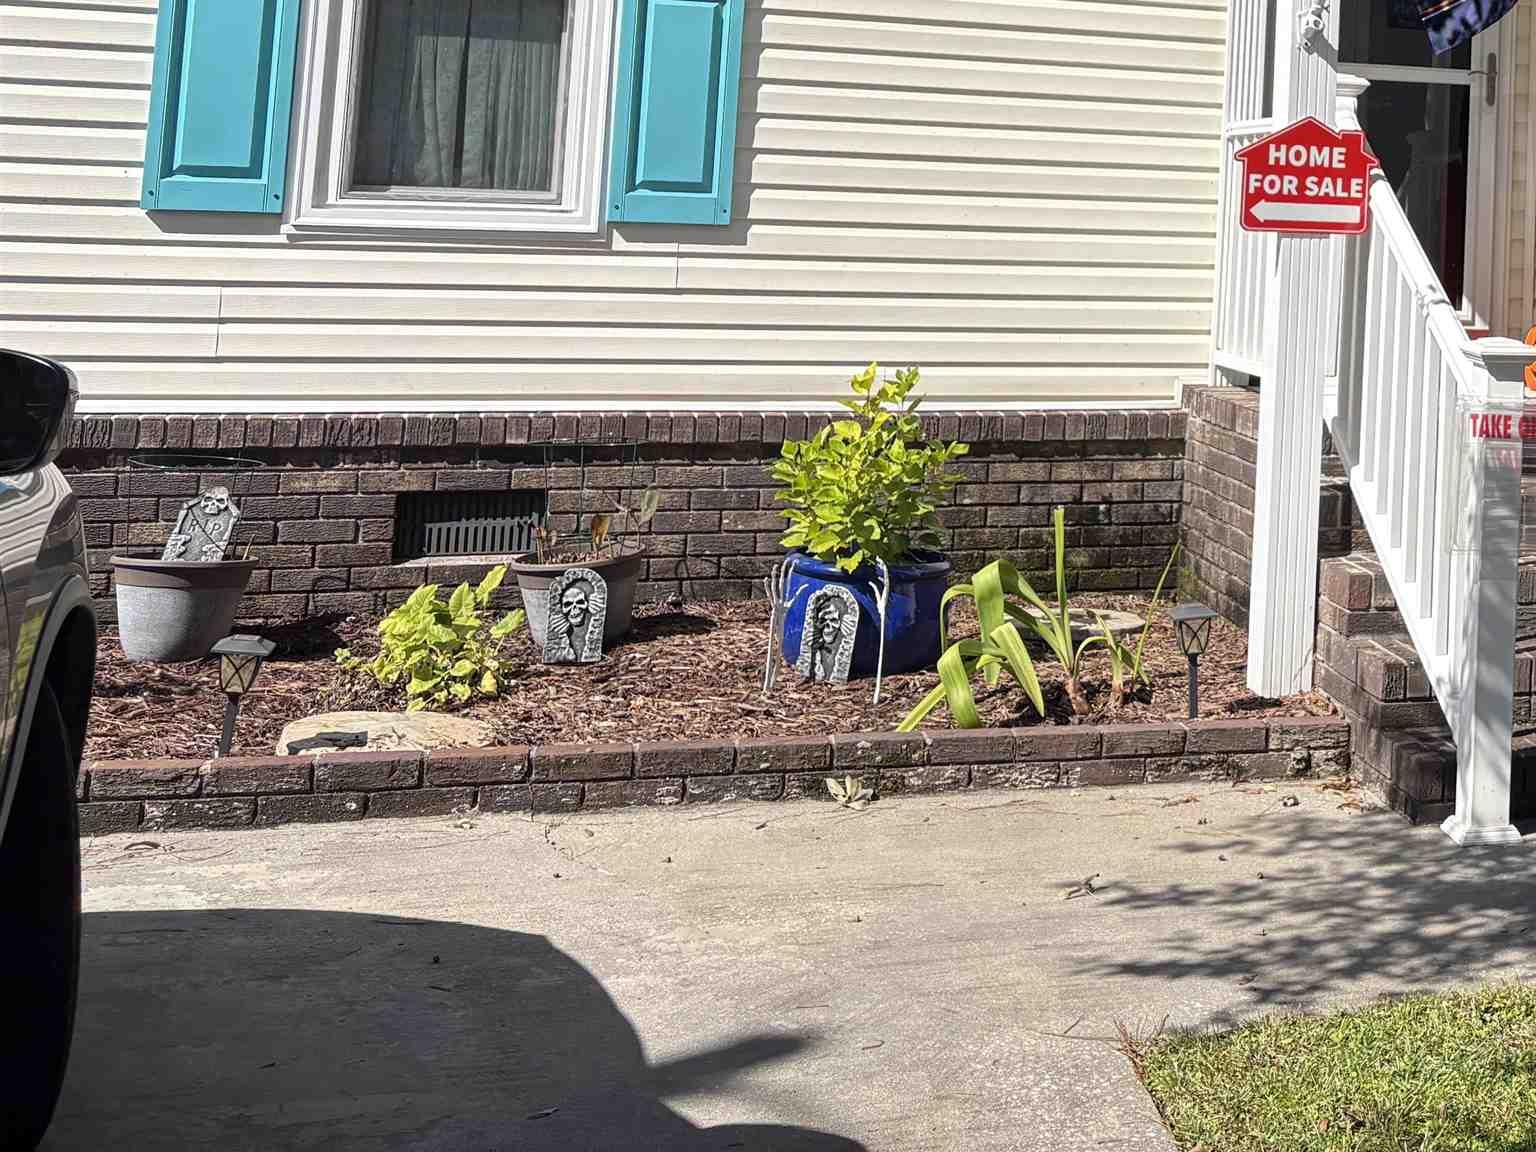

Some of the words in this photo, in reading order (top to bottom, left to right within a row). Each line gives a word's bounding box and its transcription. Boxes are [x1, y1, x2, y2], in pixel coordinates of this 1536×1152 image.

[1268, 143, 1347, 169] HOME
[1248, 173, 1299, 196] FOR
[1304, 176, 1364, 199] SALE
[1471, 414, 1513, 439] TAKE
